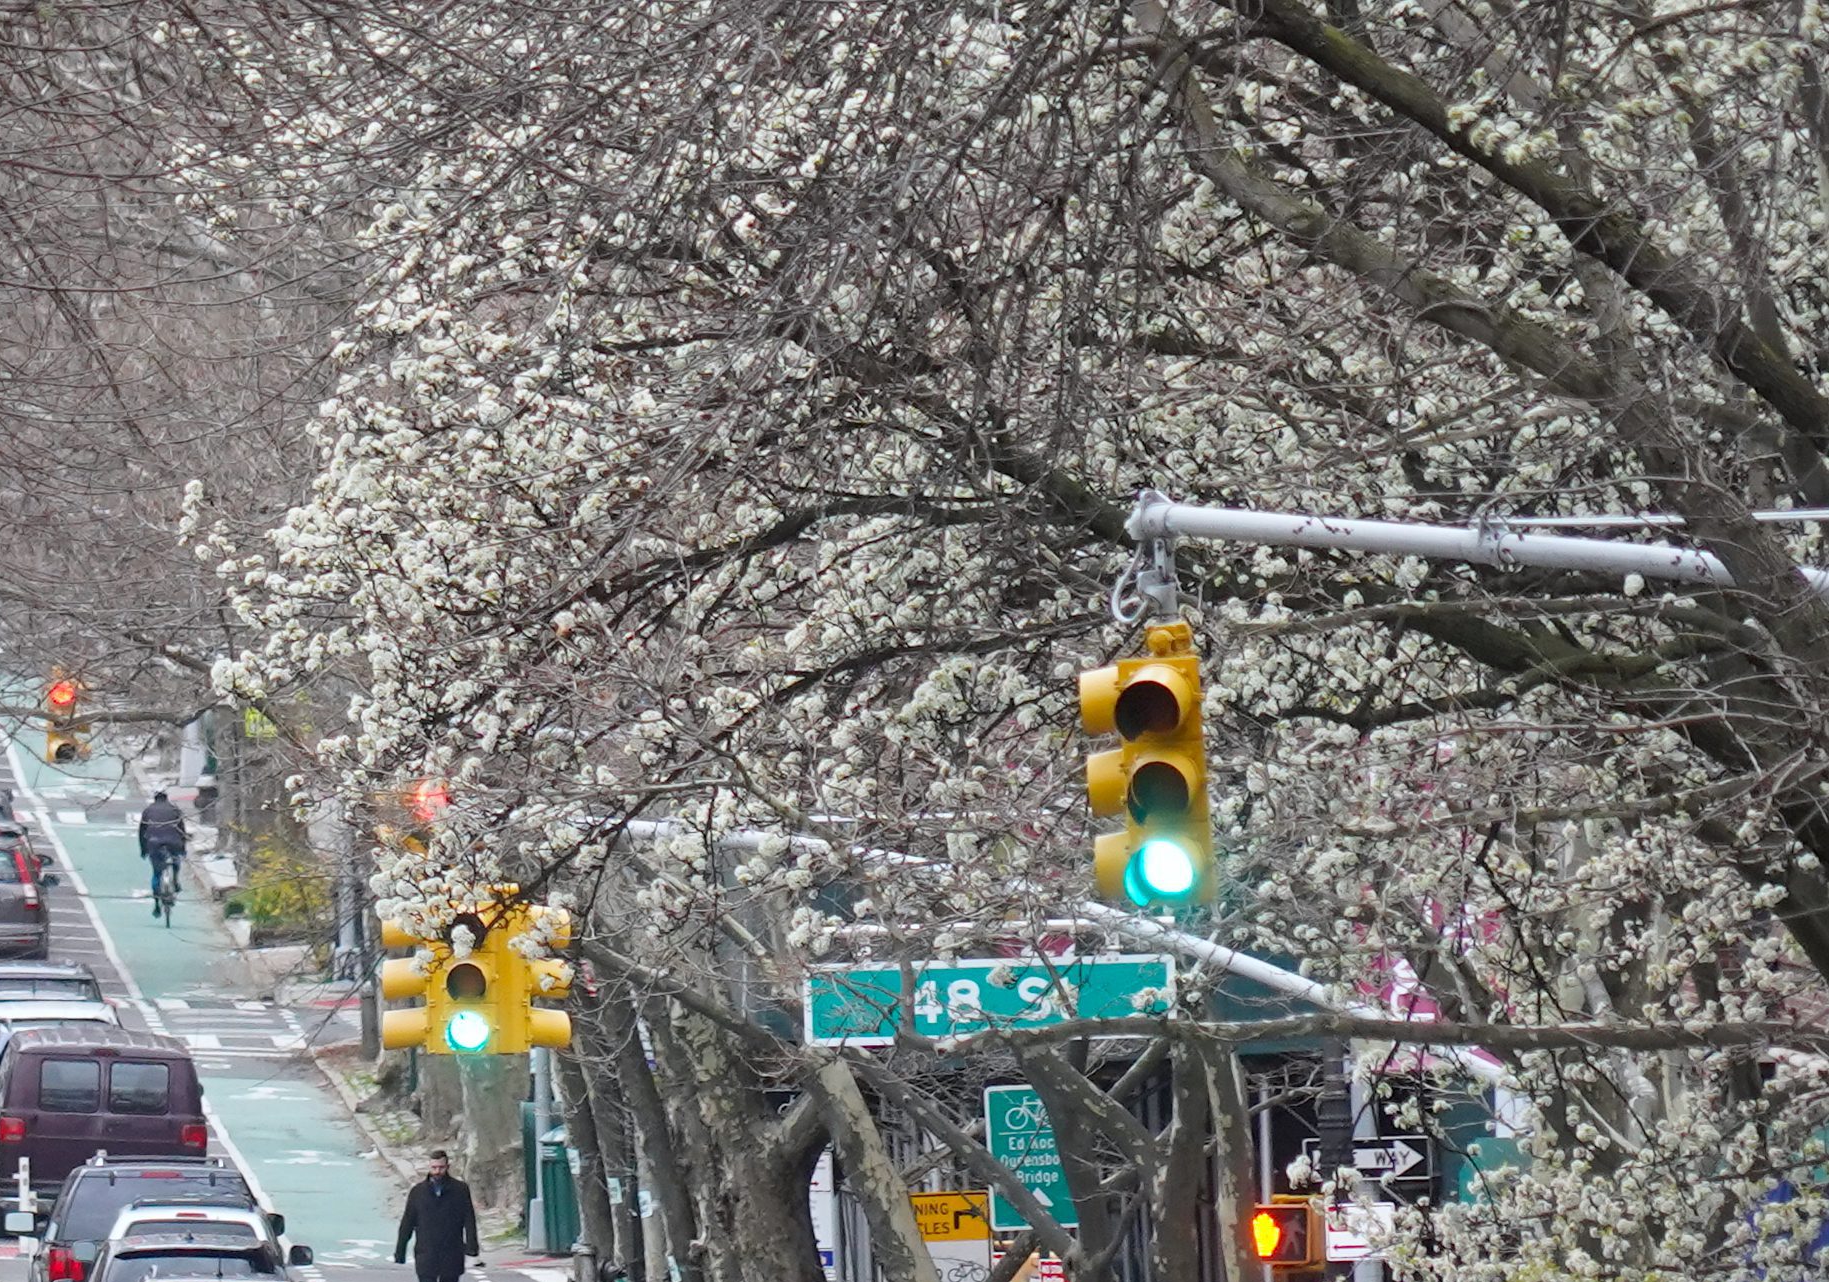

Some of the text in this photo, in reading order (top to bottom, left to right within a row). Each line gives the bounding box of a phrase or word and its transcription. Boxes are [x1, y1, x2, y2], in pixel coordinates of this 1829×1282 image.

[913, 977, 982, 1024] 48
[1008, 1136, 1026, 1150] Ed
[999, 1152, 1061, 1168] Queensbo
[1374, 1150, 1410, 1166] WAY
